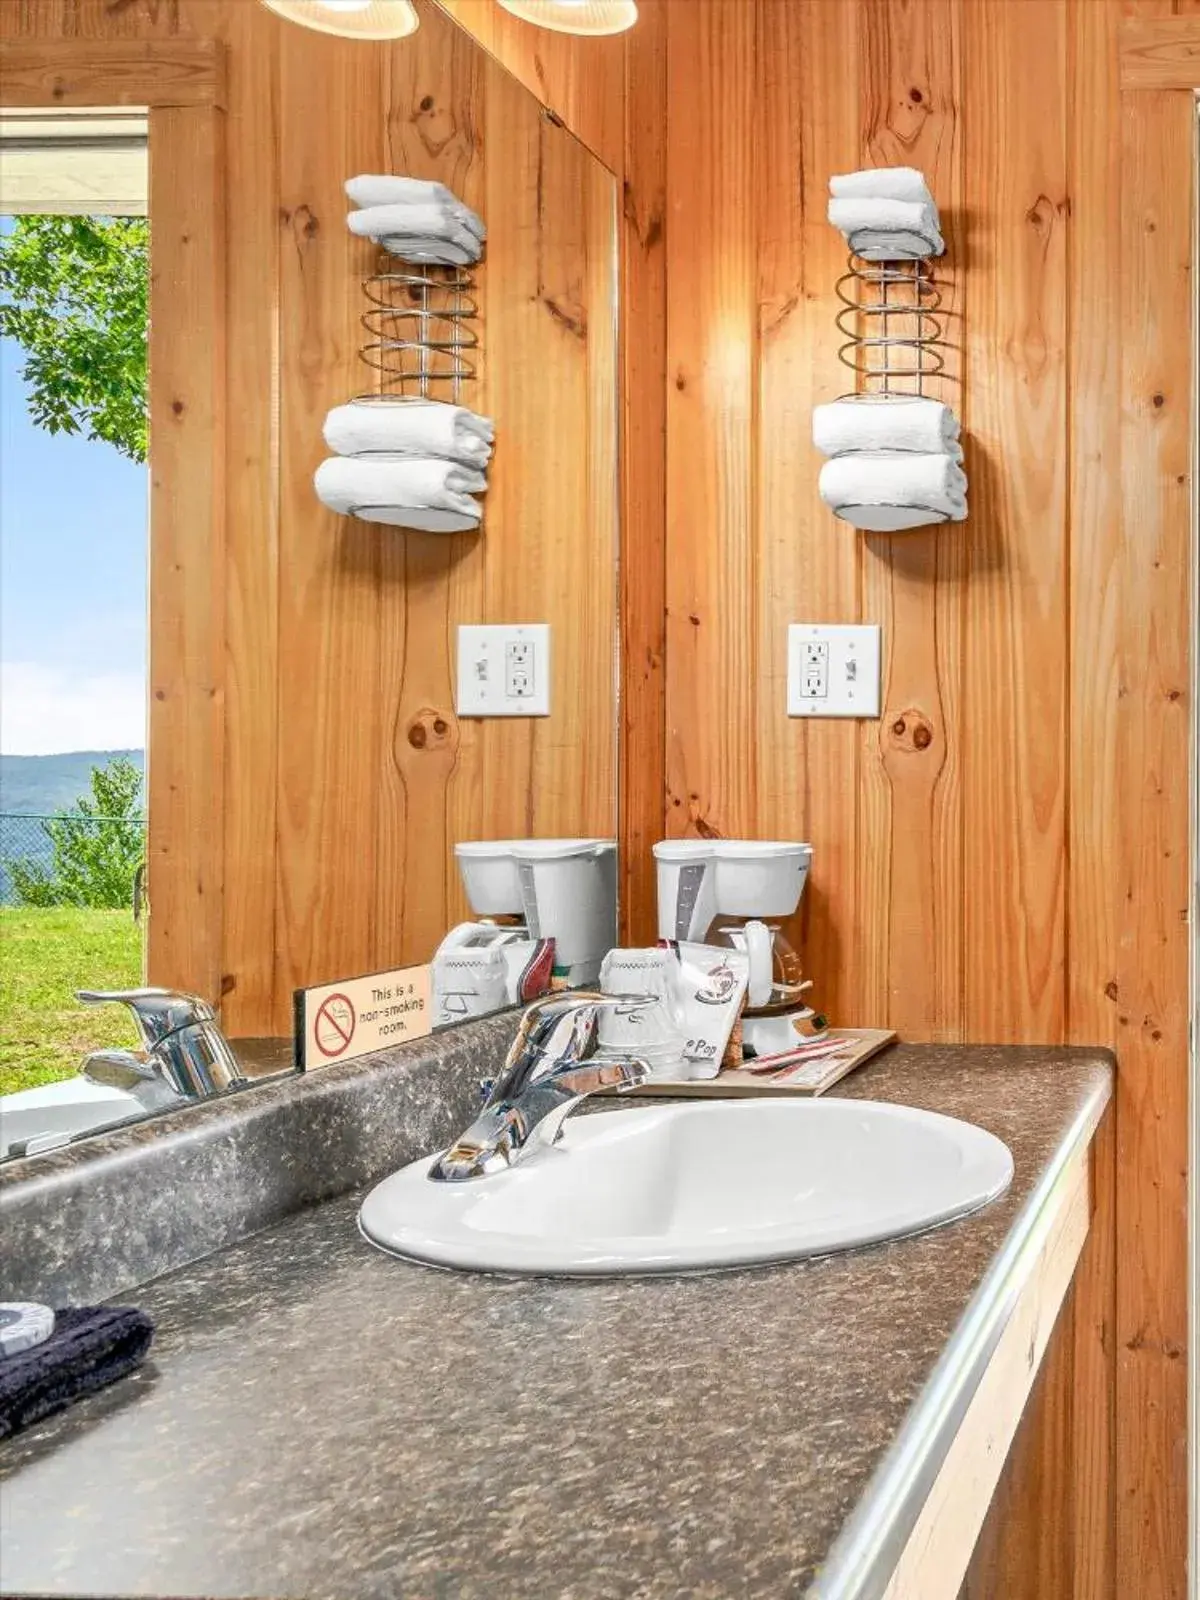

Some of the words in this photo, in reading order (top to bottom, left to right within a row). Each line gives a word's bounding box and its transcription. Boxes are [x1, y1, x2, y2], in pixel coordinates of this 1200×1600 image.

[371, 988, 391, 1002] This
[396, 985, 404, 997] is
[360, 998, 424, 1022] non-smoking
[379, 1021, 407, 1036] room.
